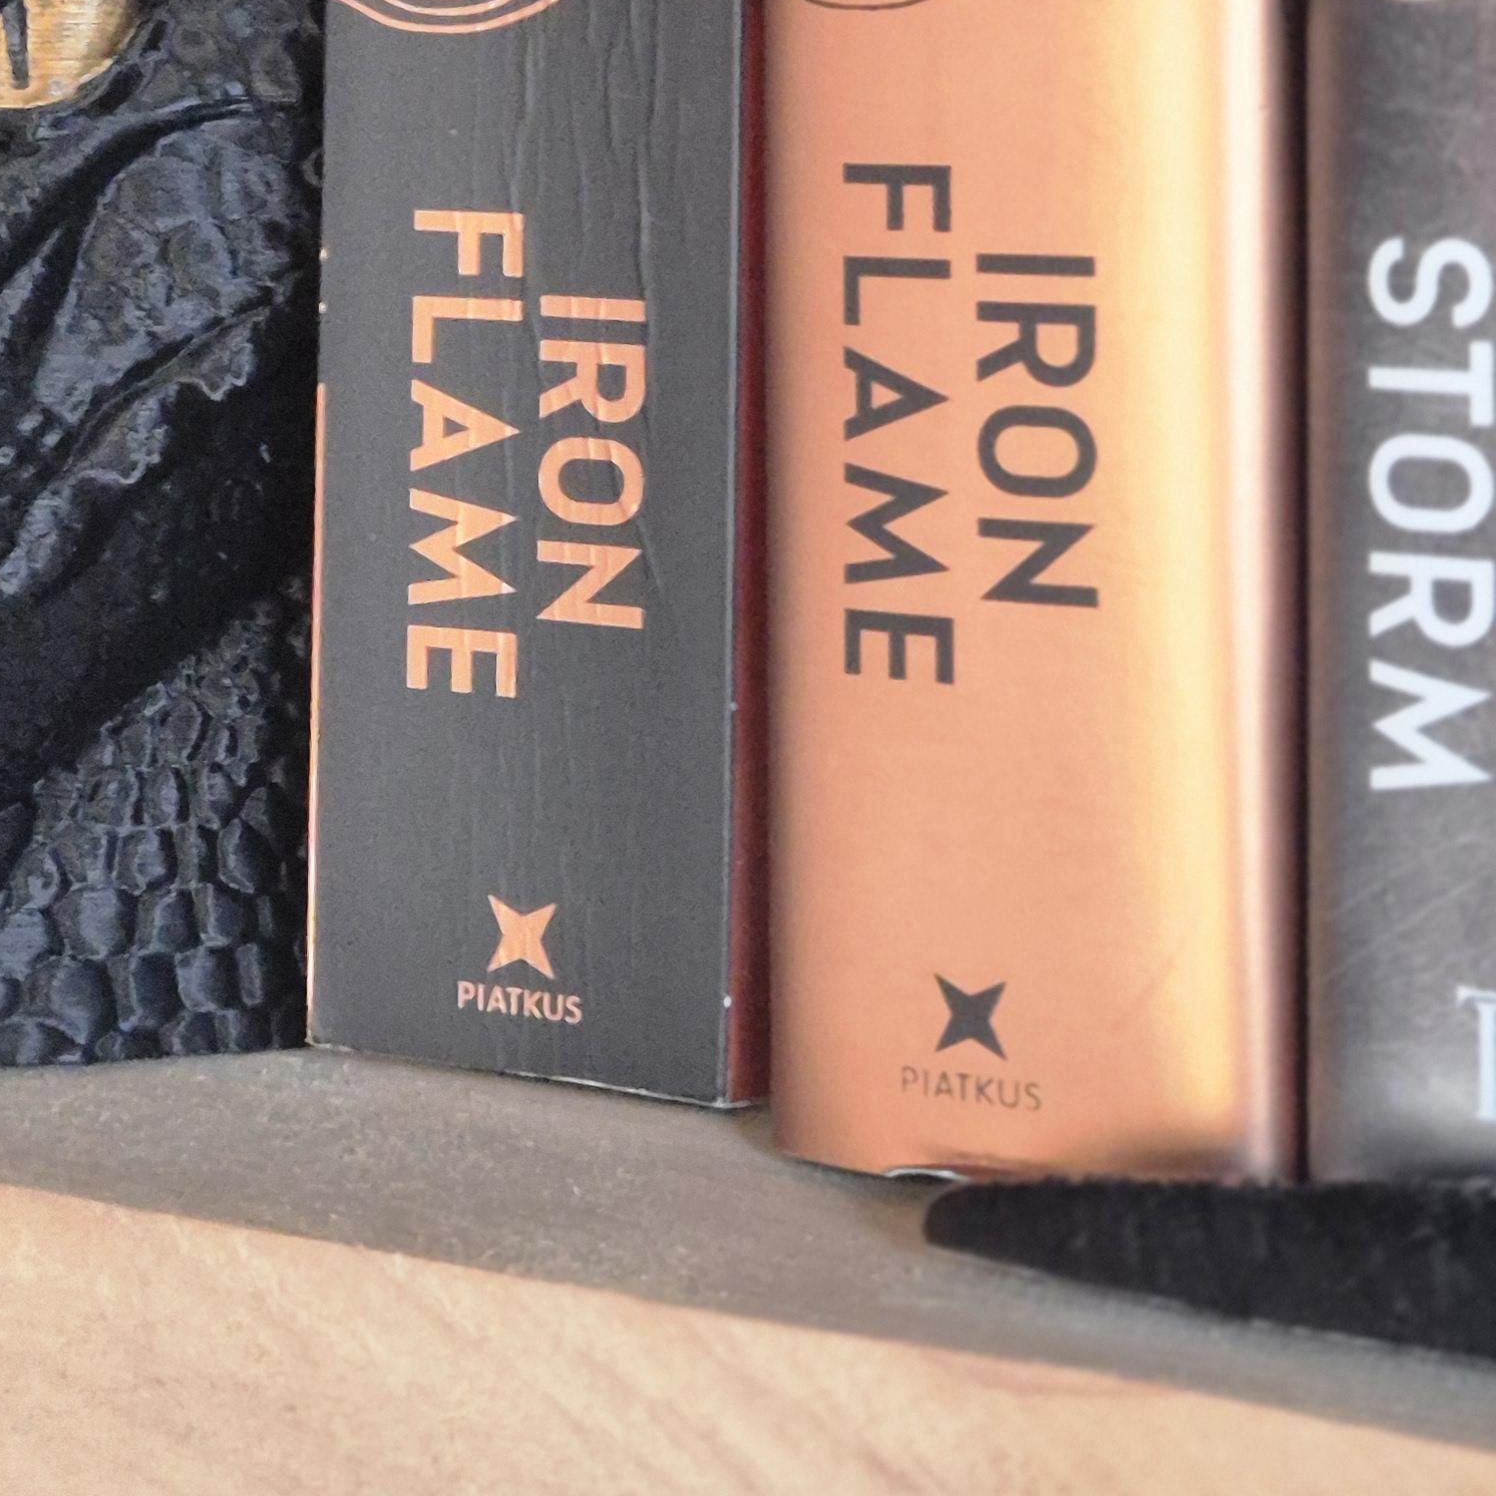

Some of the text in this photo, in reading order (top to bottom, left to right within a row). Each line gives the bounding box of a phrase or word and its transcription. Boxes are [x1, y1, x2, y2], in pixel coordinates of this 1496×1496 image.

[405, 208, 526, 700] FLAME
[536, 292, 648, 631] IRON
[841, 161, 956, 687] FLAME
[975, 252, 1100, 609] IRON
[1367, 234, 1495, 794] STORM
[457, 980, 583, 1025] PIATKUS
[901, 1065, 1042, 1111] PIATKUS
